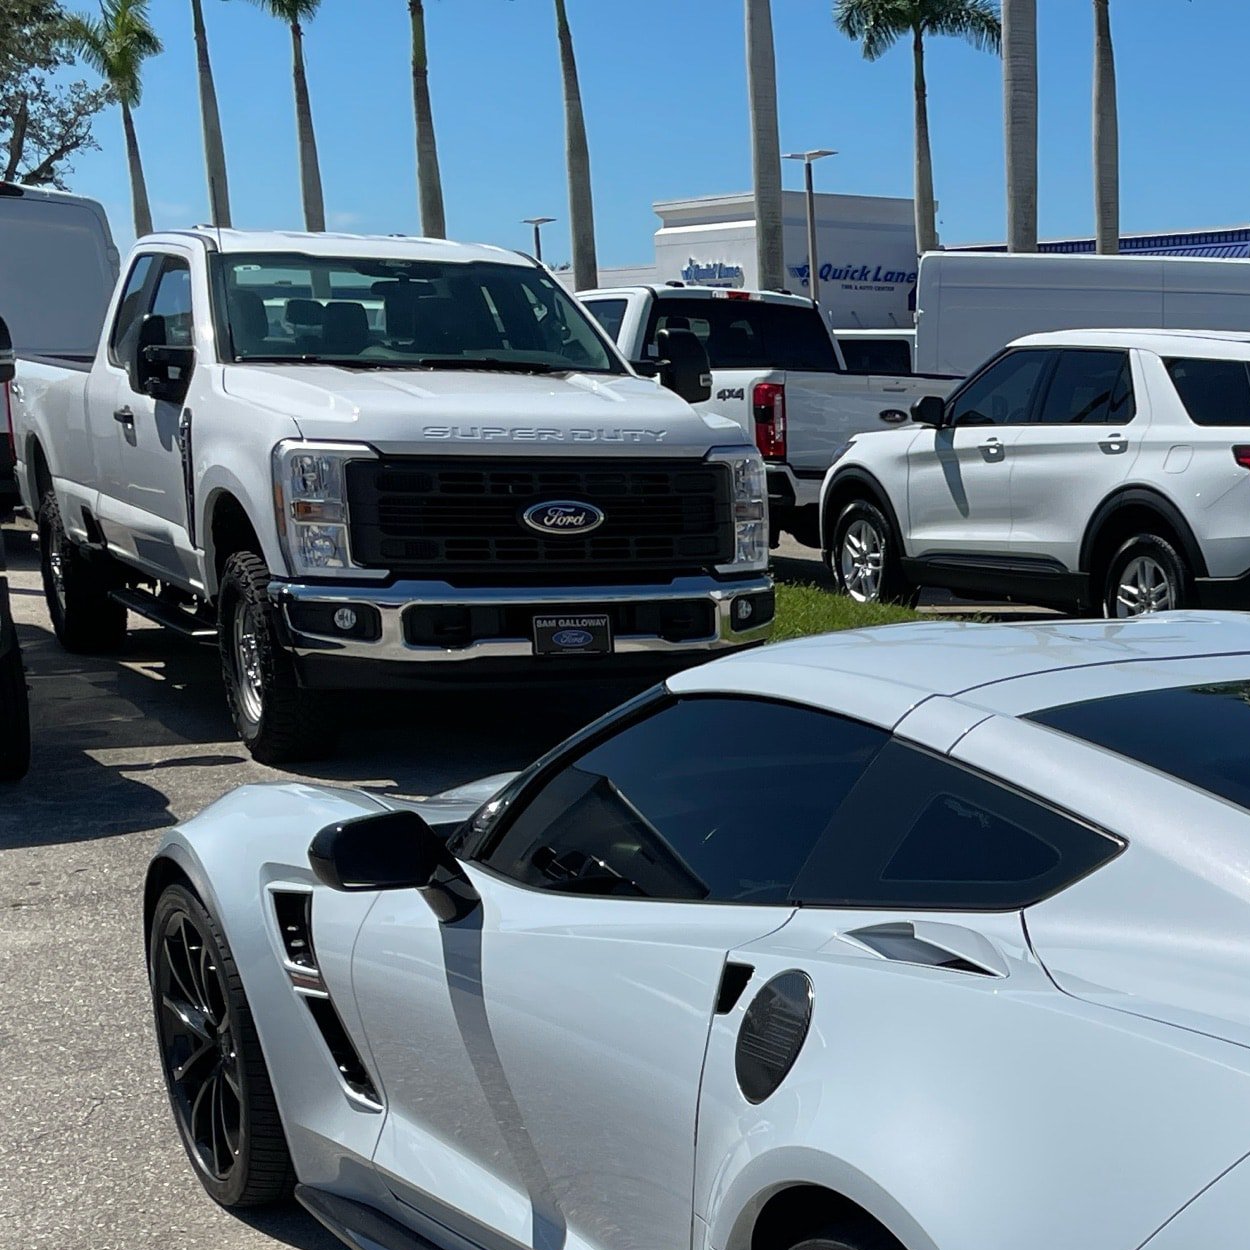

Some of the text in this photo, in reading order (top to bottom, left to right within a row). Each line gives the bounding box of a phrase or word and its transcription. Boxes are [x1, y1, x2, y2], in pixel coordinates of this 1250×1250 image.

[819, 263, 917, 283] Quick Lane
[422, 426, 667, 441] SUPER DUTY
[543, 507, 586, 526] Ford
[536, 618, 607, 628] SAM GALLOWAY
